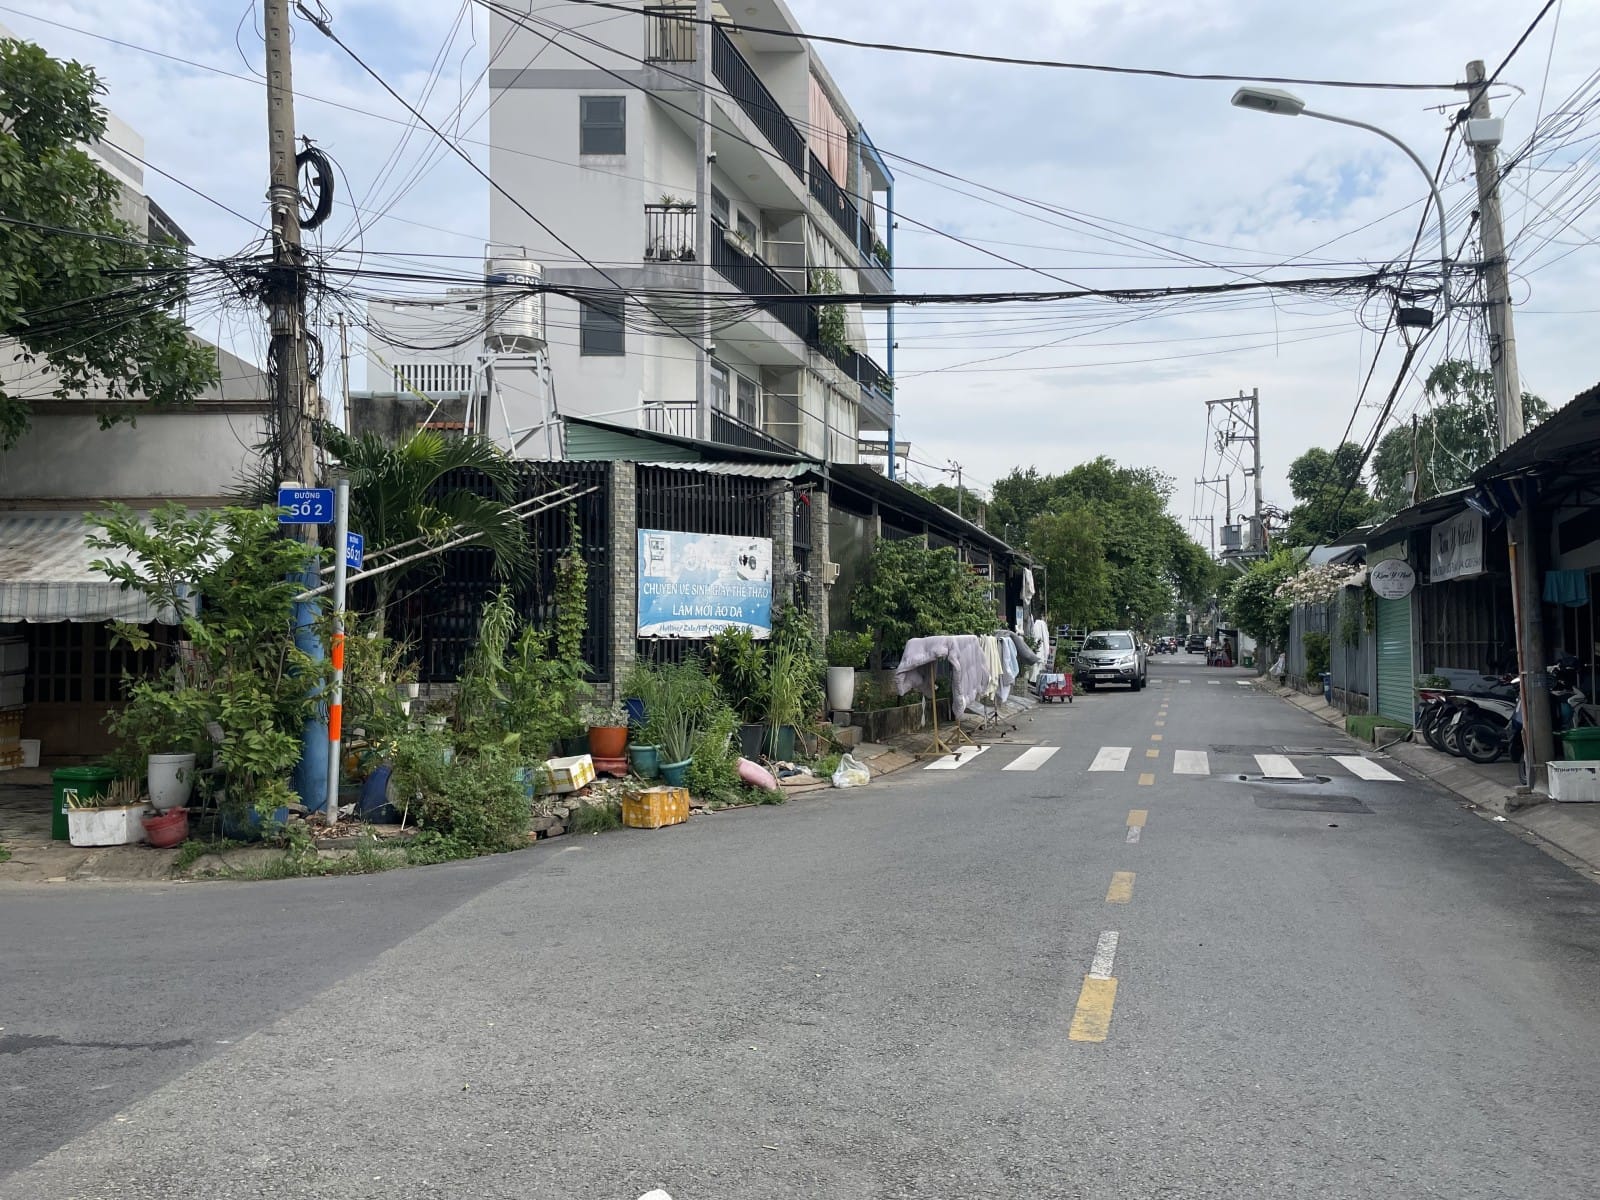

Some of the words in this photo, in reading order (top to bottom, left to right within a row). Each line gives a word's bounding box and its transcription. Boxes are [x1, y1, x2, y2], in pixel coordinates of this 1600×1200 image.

[294, 491, 320, 499] ĐƯỜNG
[290, 499, 311, 516] SỐ
[314, 503, 323, 516] 2
[346, 545, 354, 559] SỐ
[354, 549, 360, 560] 21
[691, 583, 711, 596] SINH
[747, 586, 769, 599] THAO
[694, 601, 713, 616] MỚI
[729, 606, 743, 618] DA
